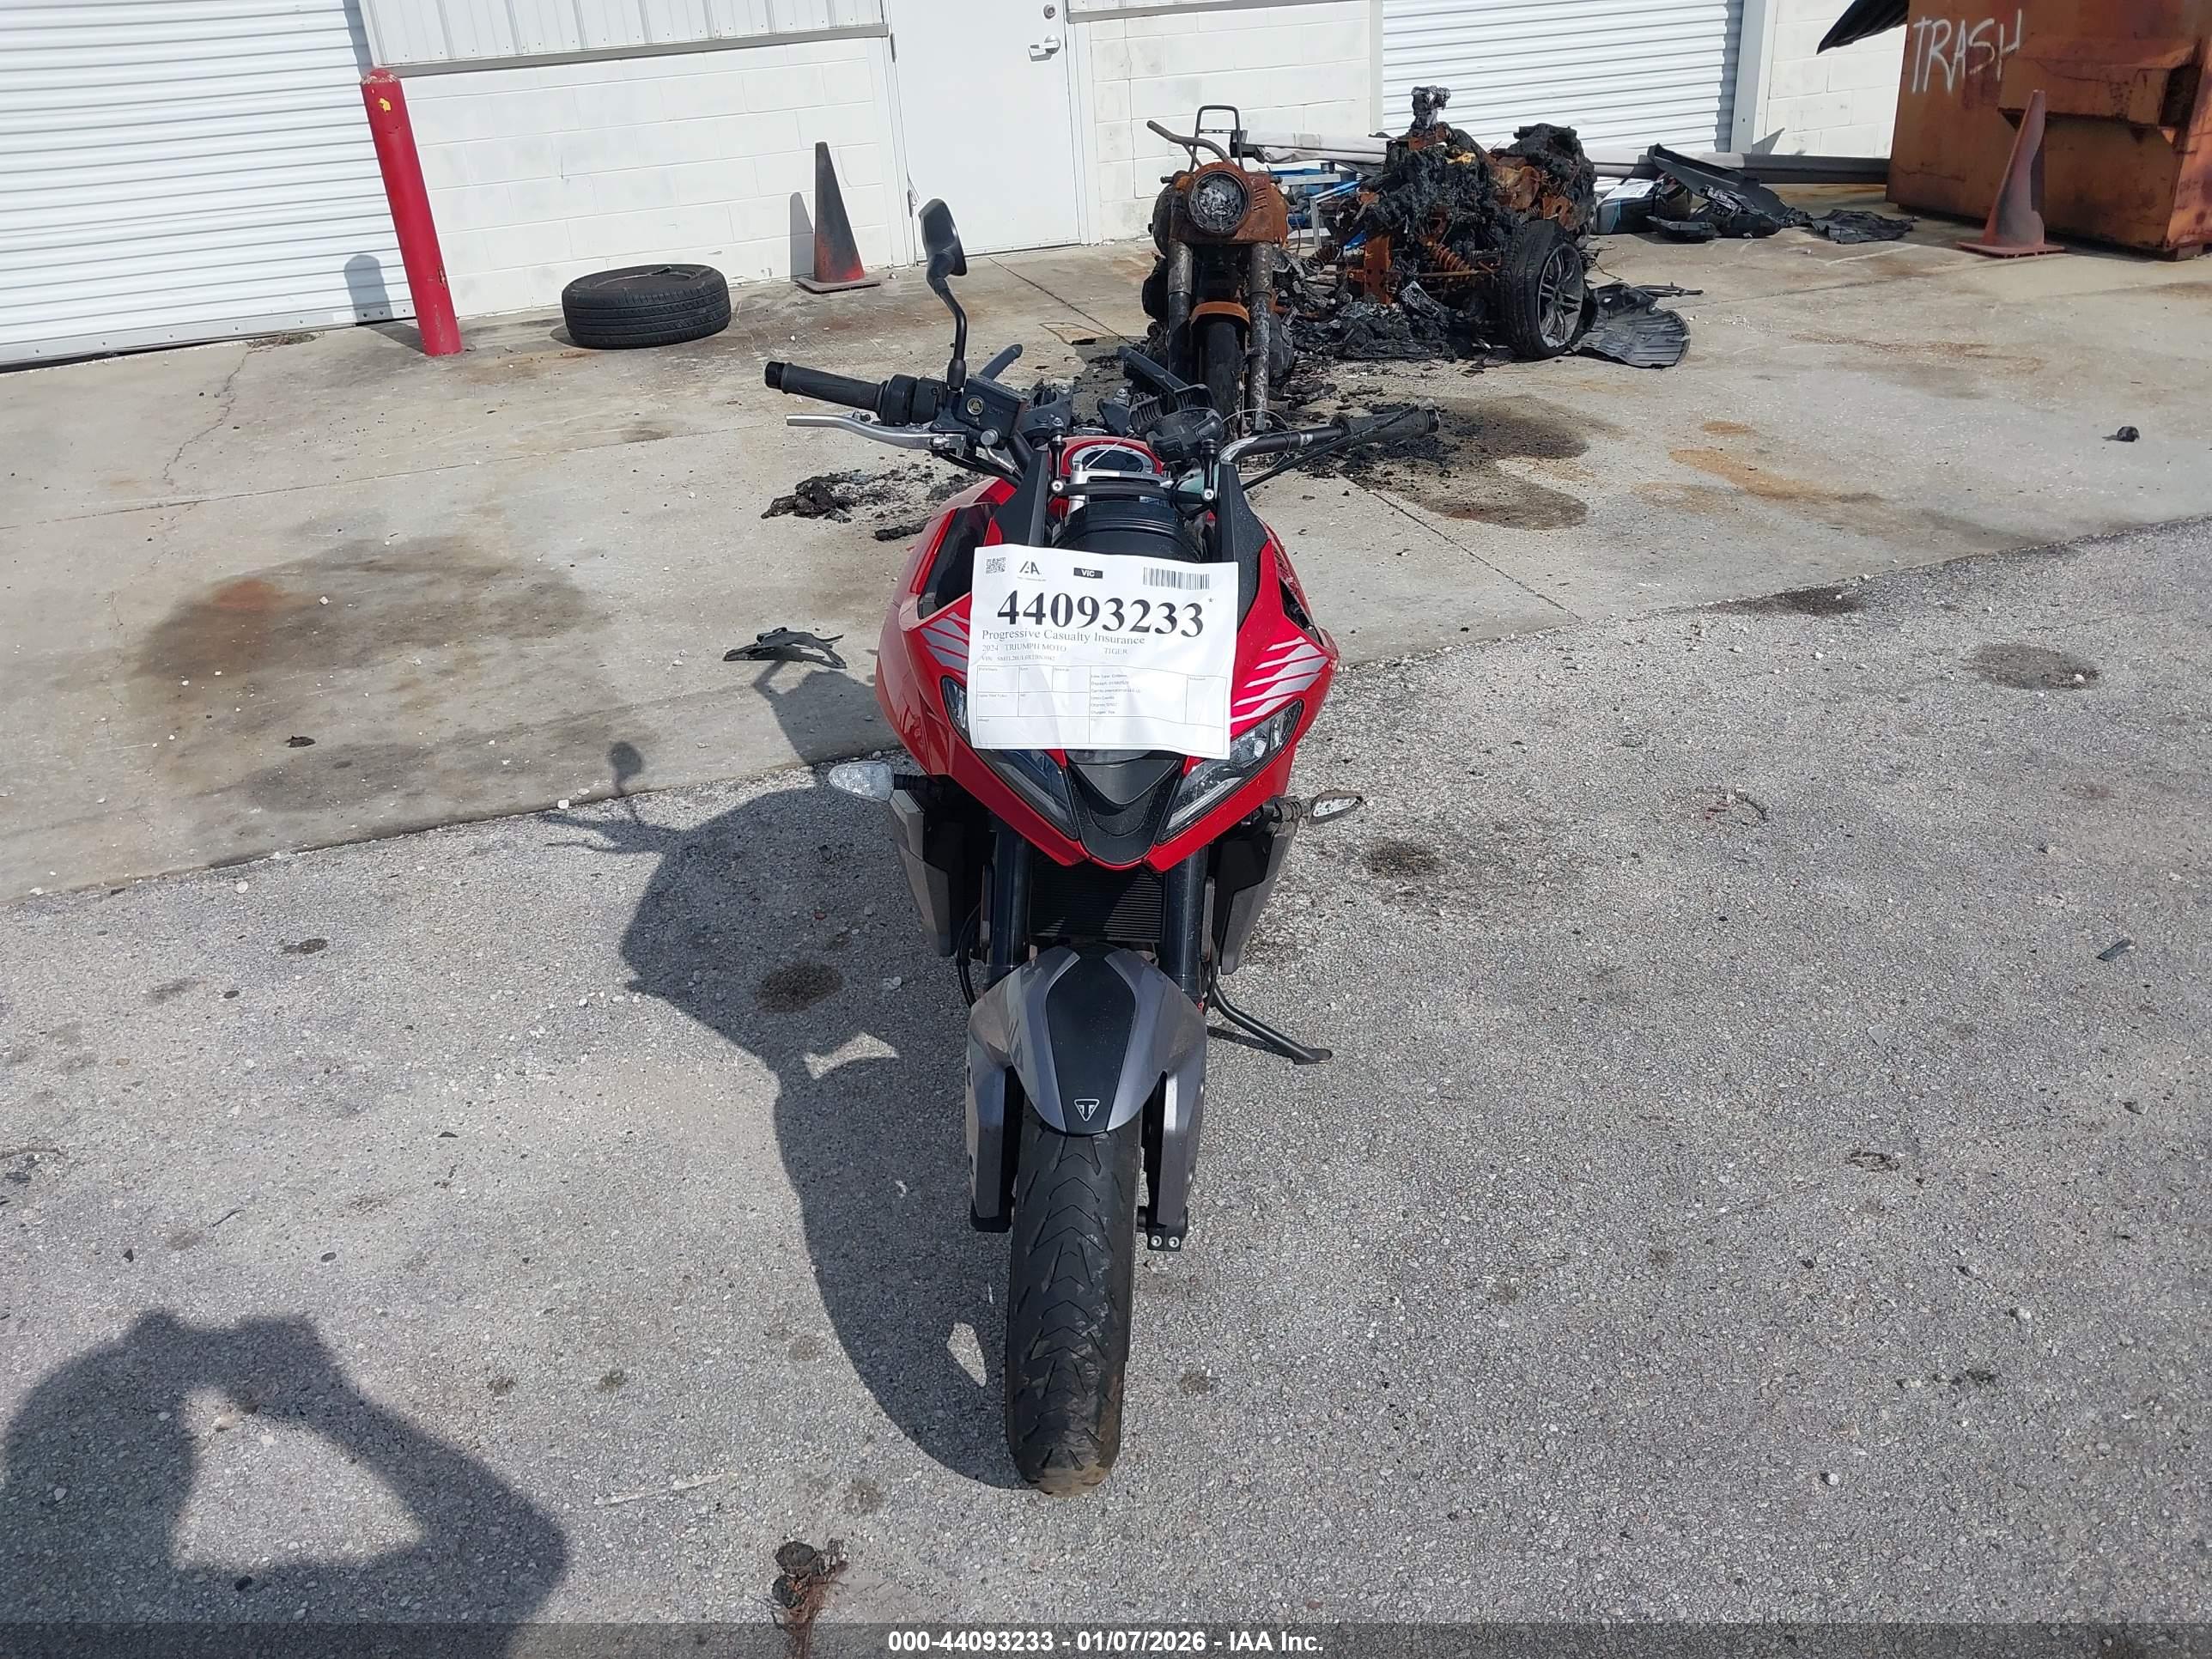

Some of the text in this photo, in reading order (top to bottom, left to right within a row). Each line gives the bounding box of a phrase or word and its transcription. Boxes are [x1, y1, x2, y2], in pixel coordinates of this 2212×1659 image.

[1912, 8, 2022, 94] TRASH
[1080, 569, 1096, 578] VIC
[997, 590, 1204, 638] 44093233
[981, 629, 1146, 645] Progressive Casualty Insurance
[1005, 642, 1040, 652] TRIUMPH
[1042, 643, 1067, 653] MOTO
[1104, 647, 1128, 656] TIGER
